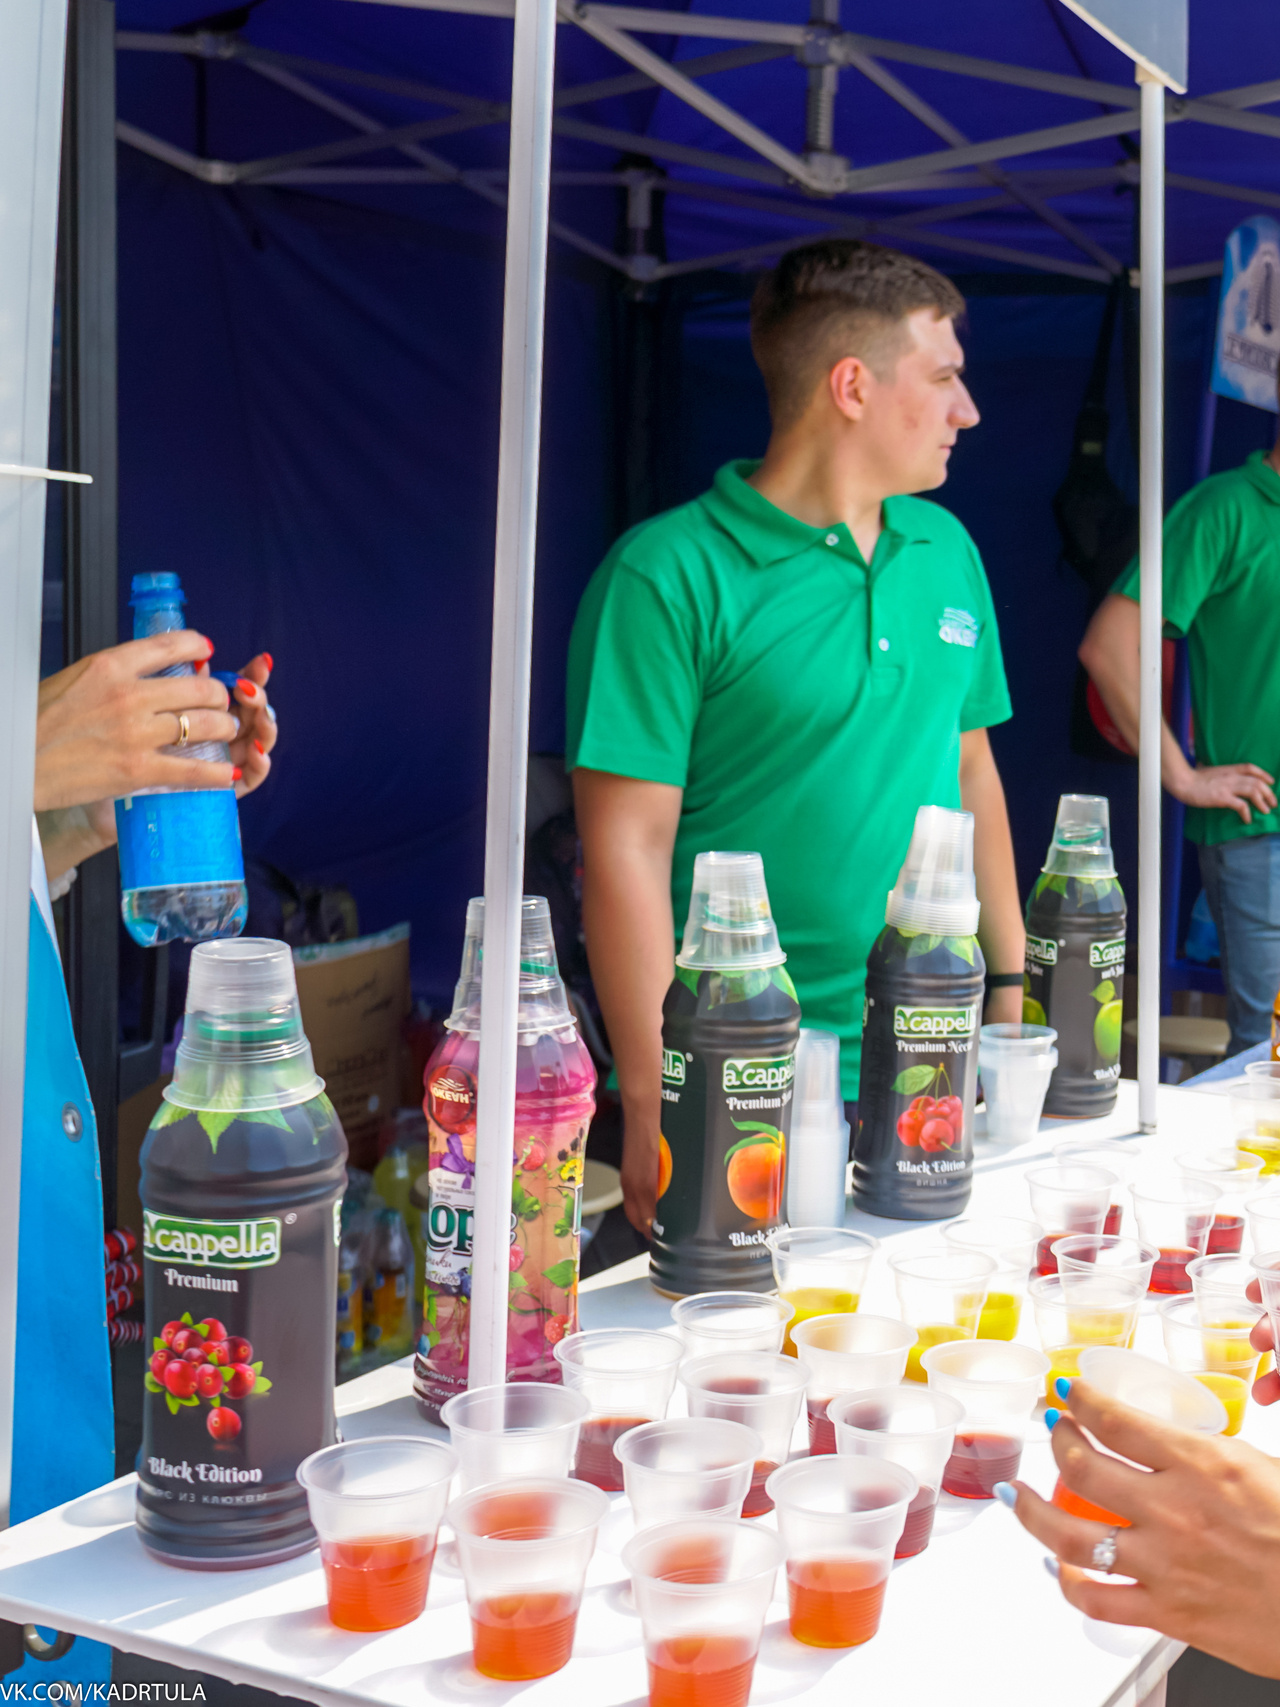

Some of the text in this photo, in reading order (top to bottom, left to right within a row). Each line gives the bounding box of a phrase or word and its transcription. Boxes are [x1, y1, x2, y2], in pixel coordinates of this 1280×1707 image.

[896, 1040, 946, 1054] Premium
[726, 1096, 781, 1112] Premium
[896, 1160, 966, 1176] Black Edition
[729, 1229, 767, 1248] Black
[164, 1268, 239, 1293] Premium
[148, 1456, 263, 1484] Black Edition
